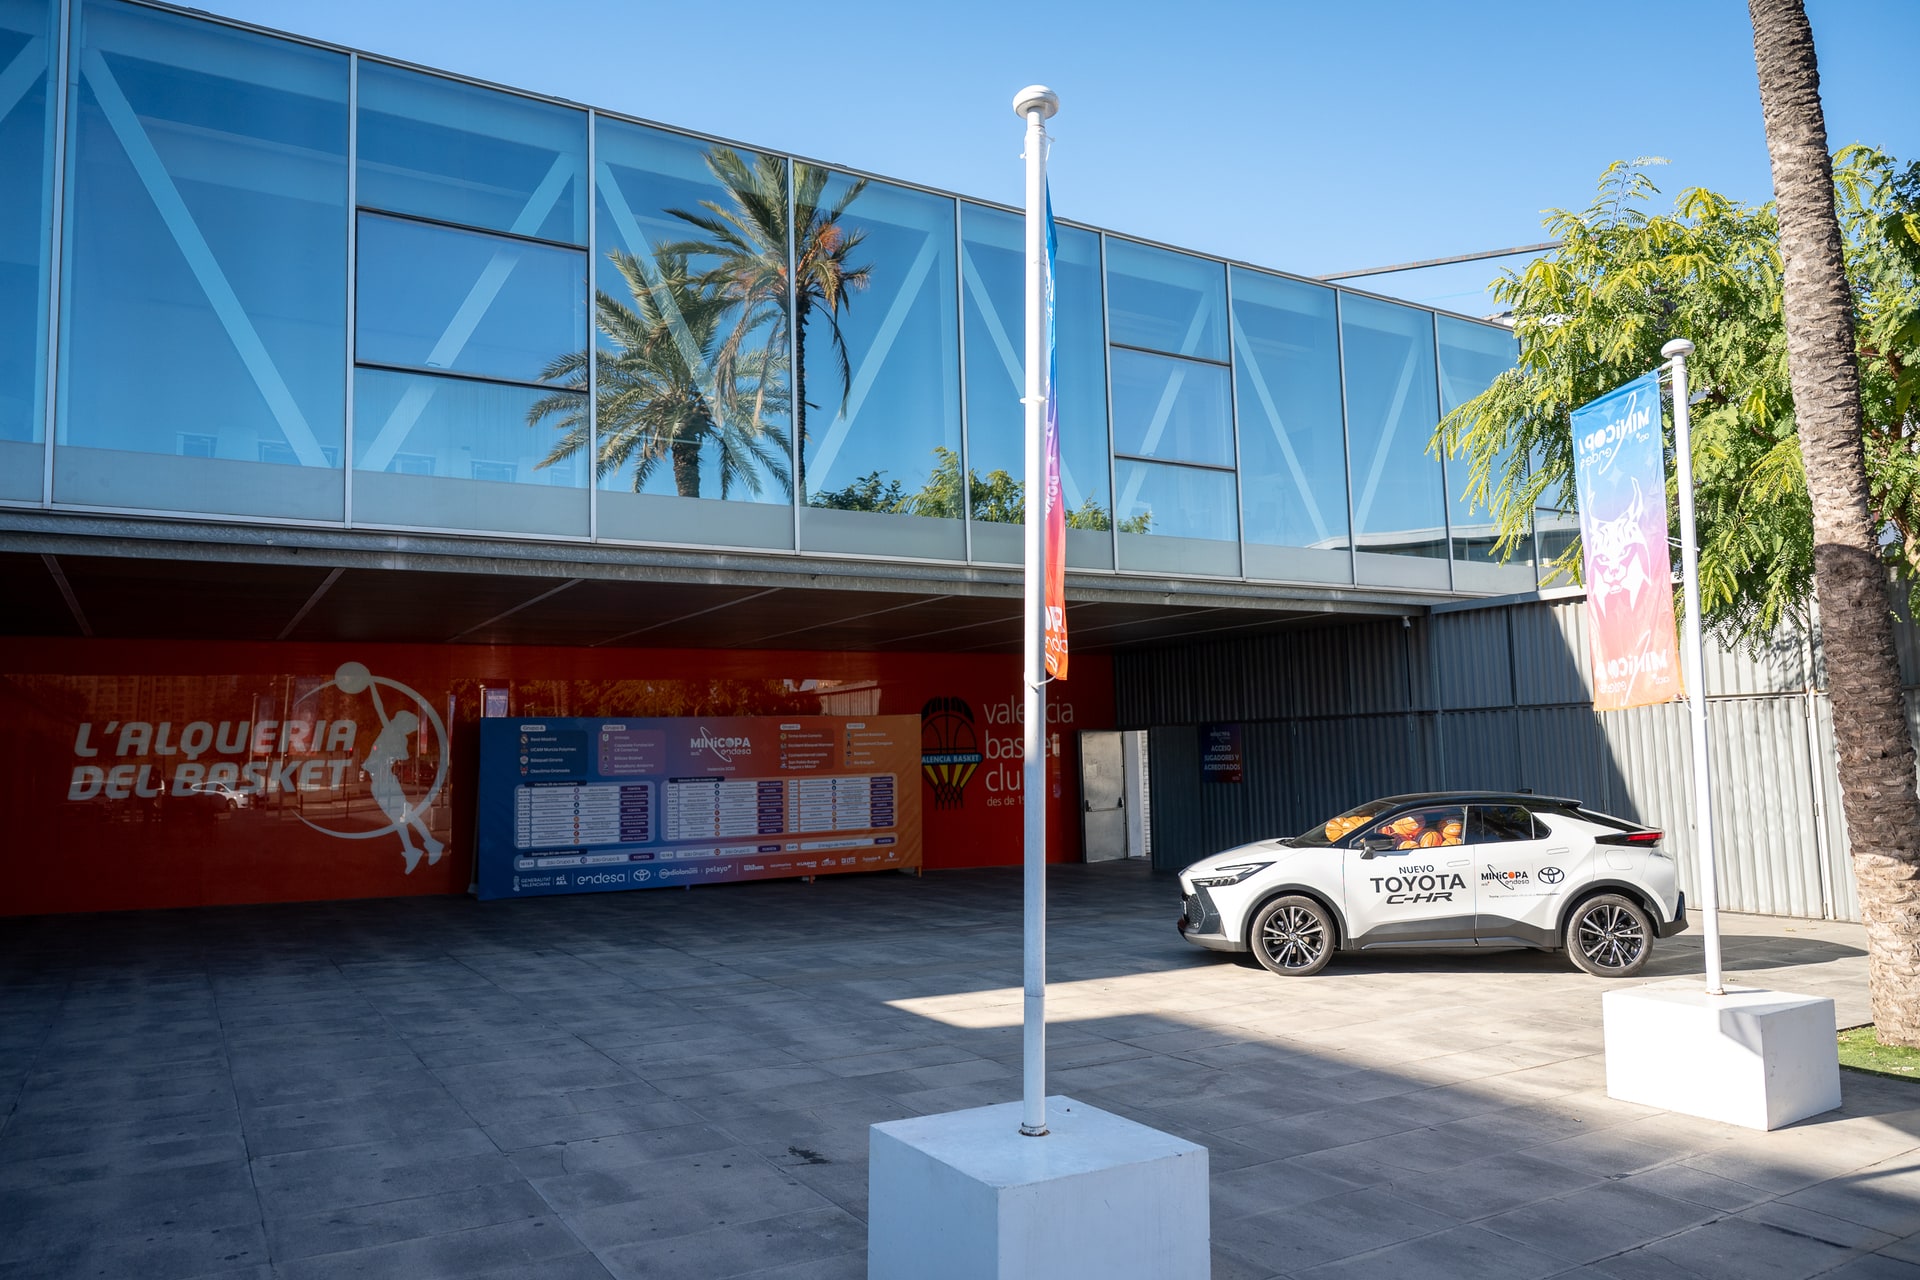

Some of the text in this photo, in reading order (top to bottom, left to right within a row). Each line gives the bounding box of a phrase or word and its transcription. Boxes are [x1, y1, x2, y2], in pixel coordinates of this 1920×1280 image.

[983, 695, 1074, 724] valecia
[1211, 744, 1232, 752] ACCESO
[922, 754, 979, 764] ALENCIA BASKET
[67, 759, 352, 801] DEL BASKET
[985, 762, 1024, 792] clu
[1004, 795, 1015, 806] de
[1399, 864, 1434, 874] NUEVO
[577, 873, 625, 885] endesa
[1370, 874, 1466, 893] TOYOTA
[1386, 892, 1453, 905] C-HR
